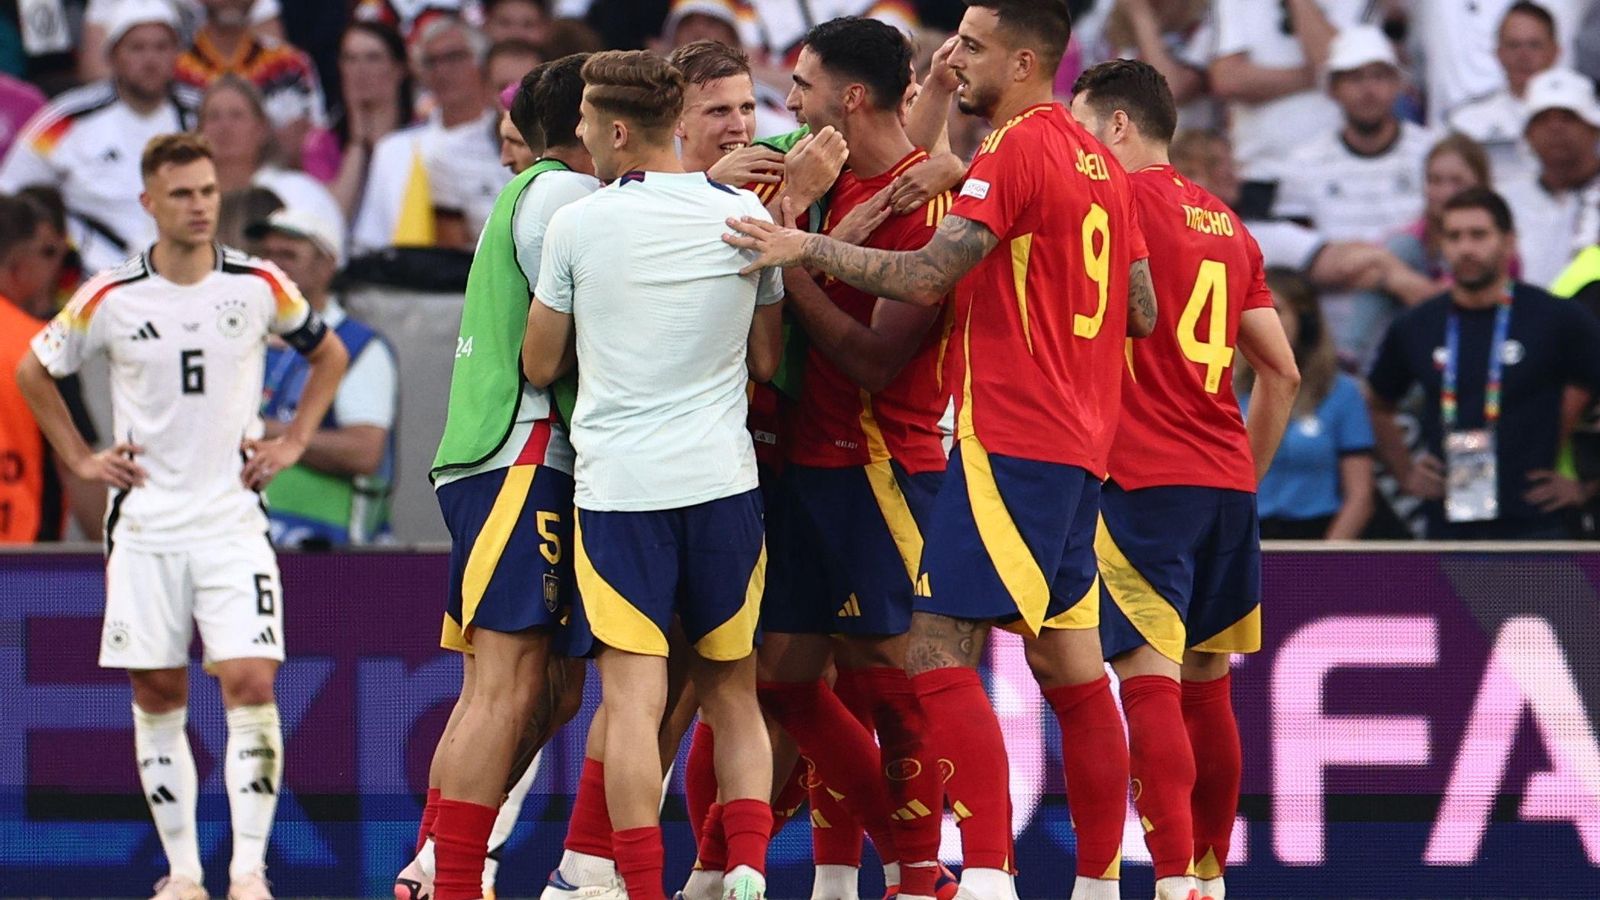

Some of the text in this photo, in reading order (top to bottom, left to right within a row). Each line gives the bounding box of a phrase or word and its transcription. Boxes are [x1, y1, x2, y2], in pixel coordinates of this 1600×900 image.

[1181, 203, 1234, 237] NACHO
[1073, 202, 1110, 340] 9
[1176, 258, 1234, 395] 4
[181, 349, 204, 395] 6
[536, 510, 562, 566] 5
[253, 573, 275, 616] 6
